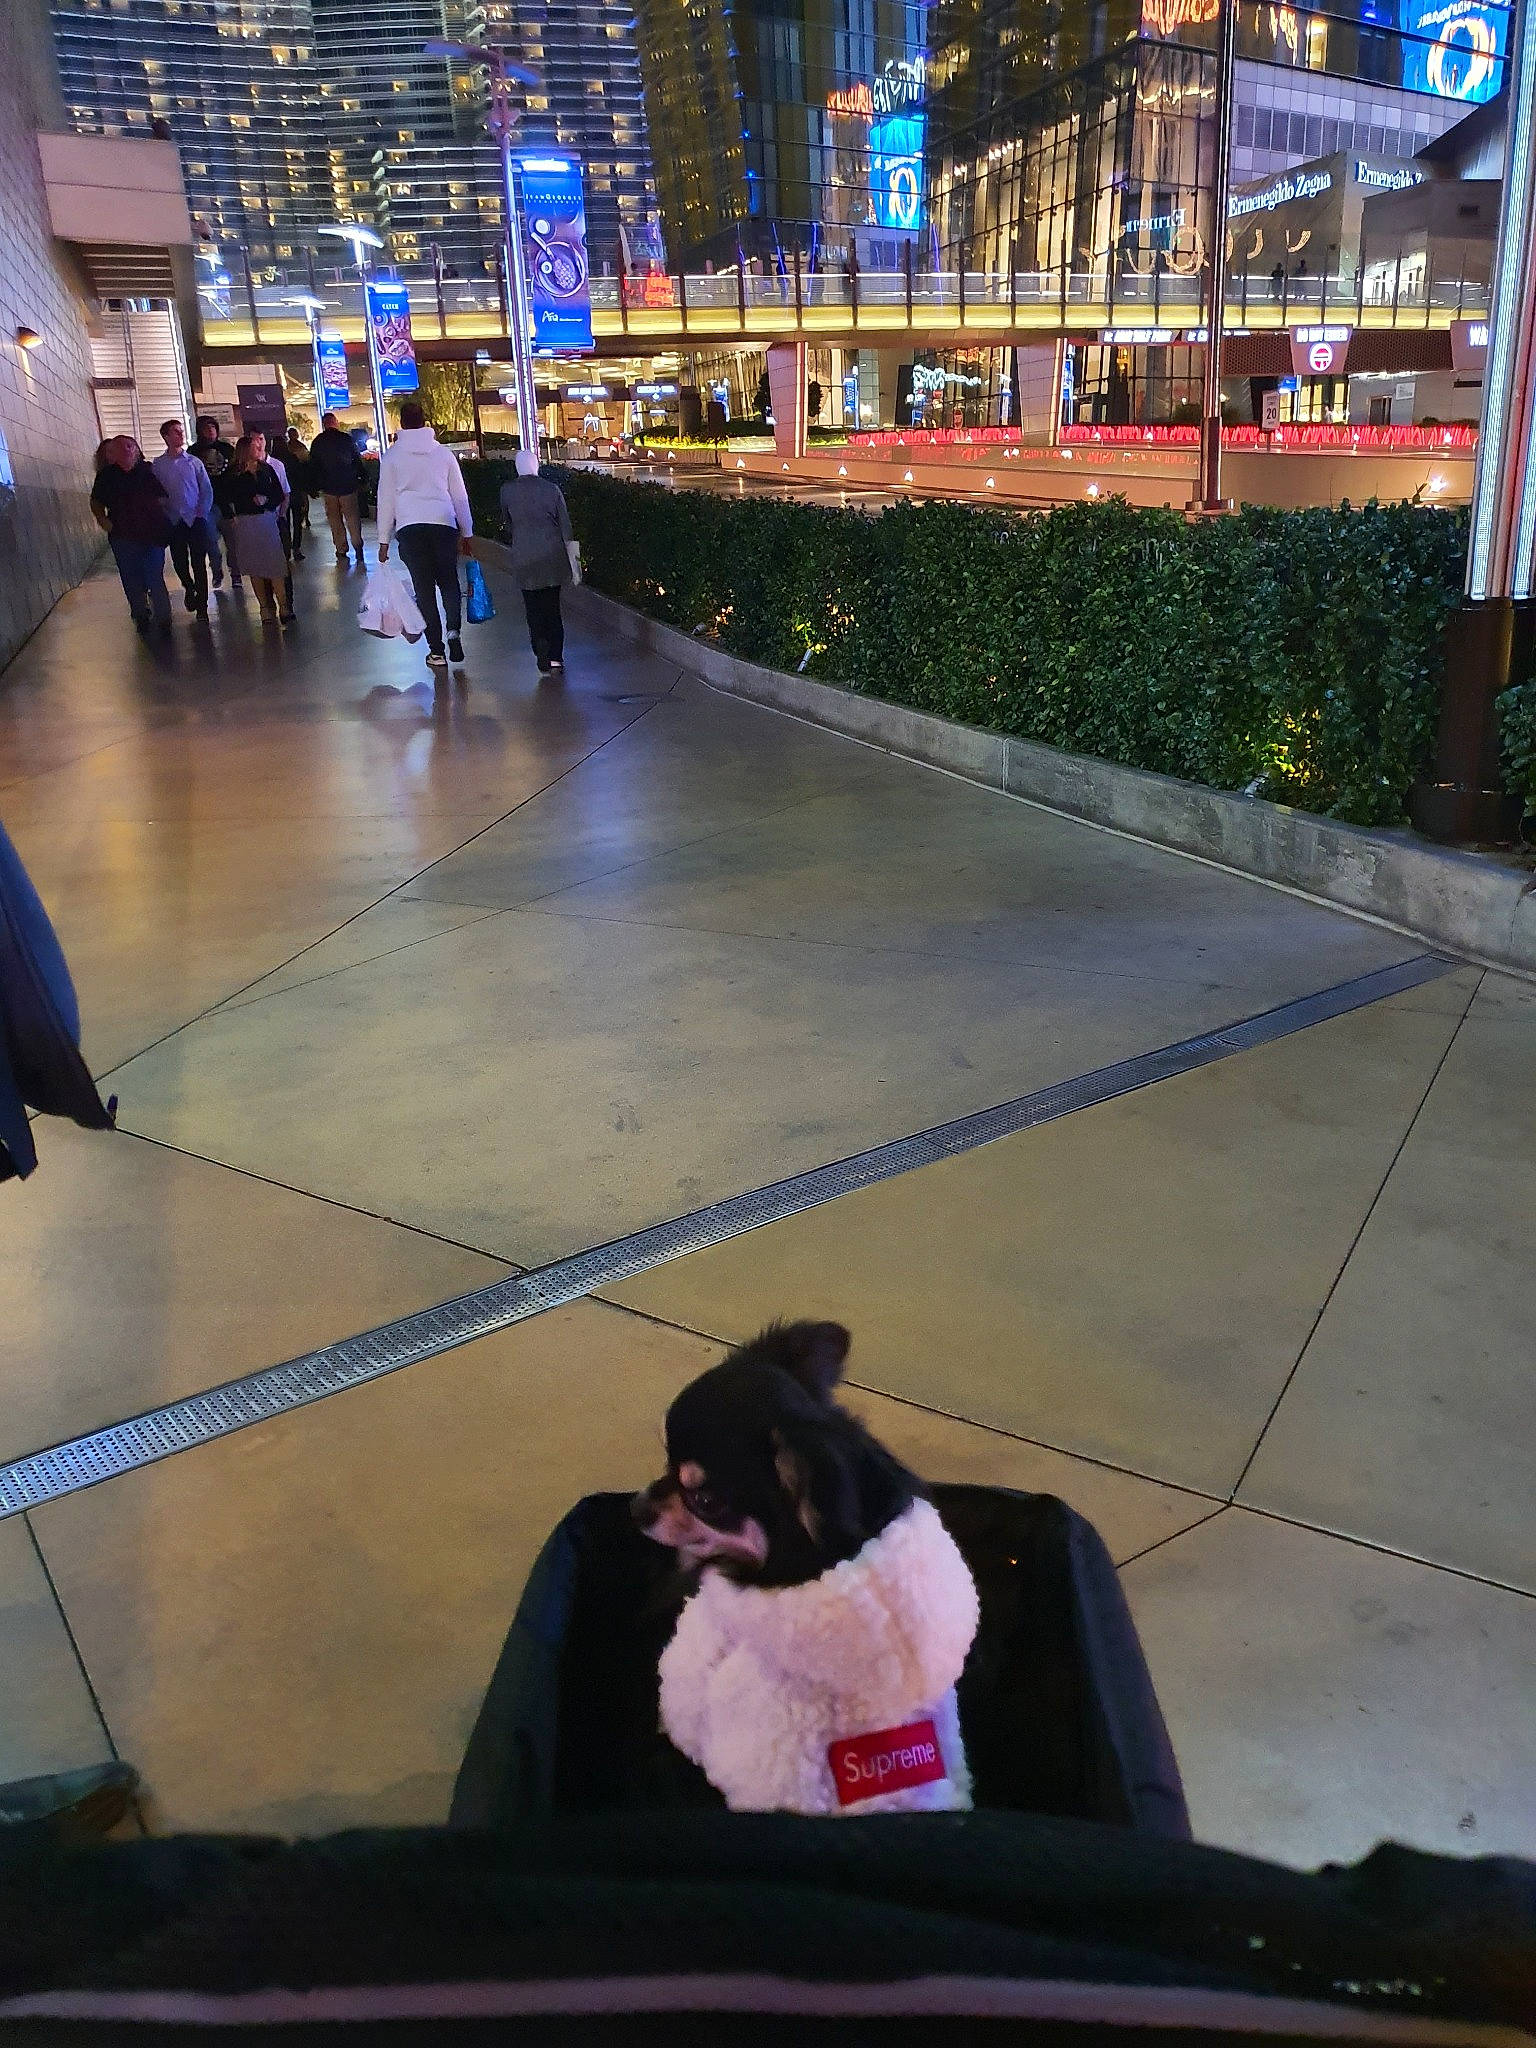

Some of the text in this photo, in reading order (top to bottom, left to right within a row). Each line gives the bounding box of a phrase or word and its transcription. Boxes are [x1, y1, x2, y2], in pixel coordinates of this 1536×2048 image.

[1228, 172, 1331, 218] Ermenegildo Zegna
[1266, 407, 1277, 420] 20
[843, 1741, 936, 1783] Supreme
